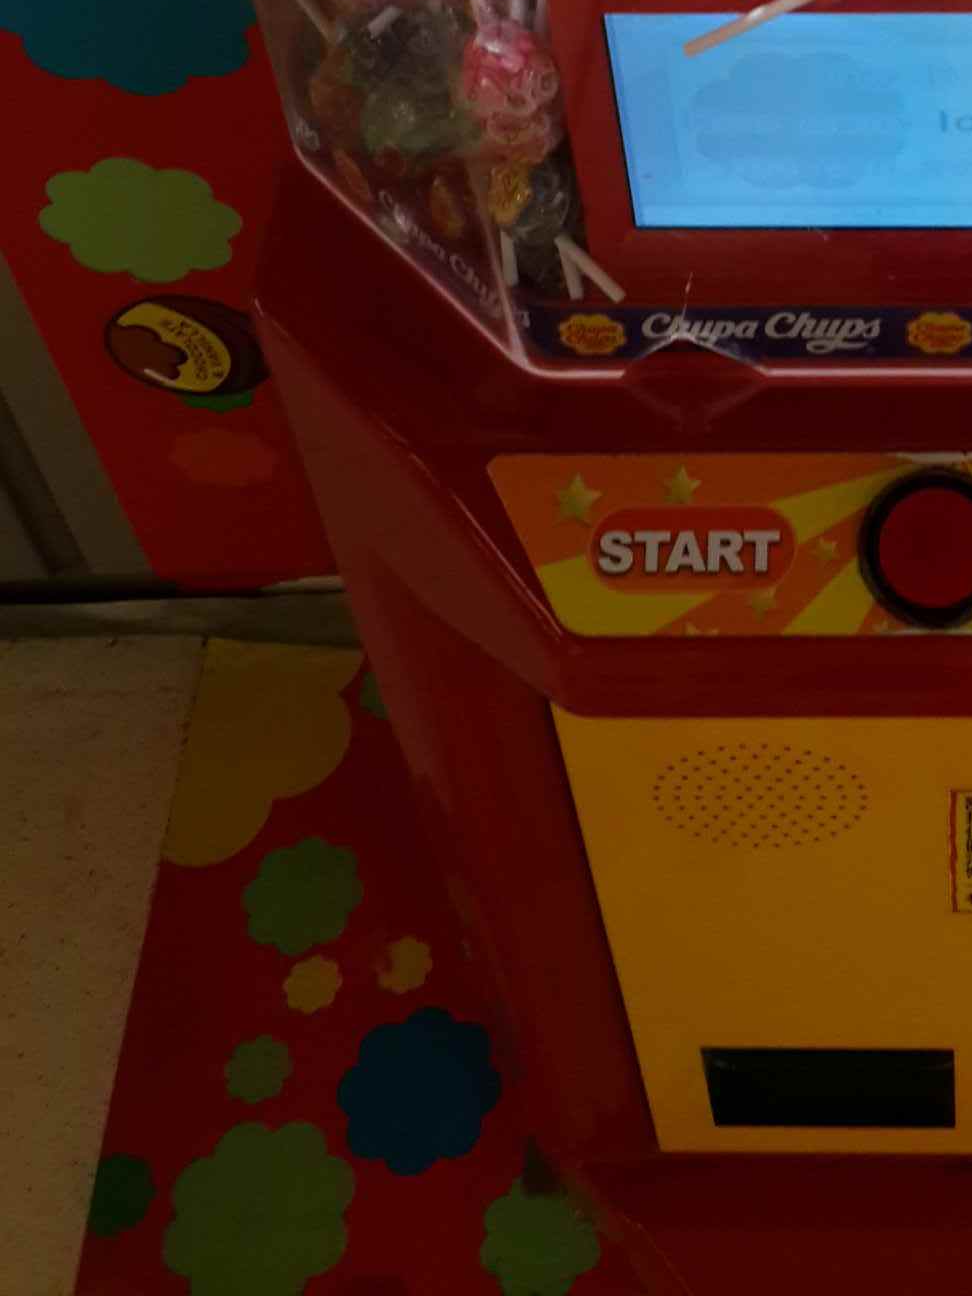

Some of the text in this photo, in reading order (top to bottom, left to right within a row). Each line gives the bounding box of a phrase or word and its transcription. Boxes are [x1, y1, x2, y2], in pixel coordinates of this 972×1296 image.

[641, 311, 760, 345] Chupa
[764, 311, 881, 354] Chups
[599, 530, 780, 573] START
